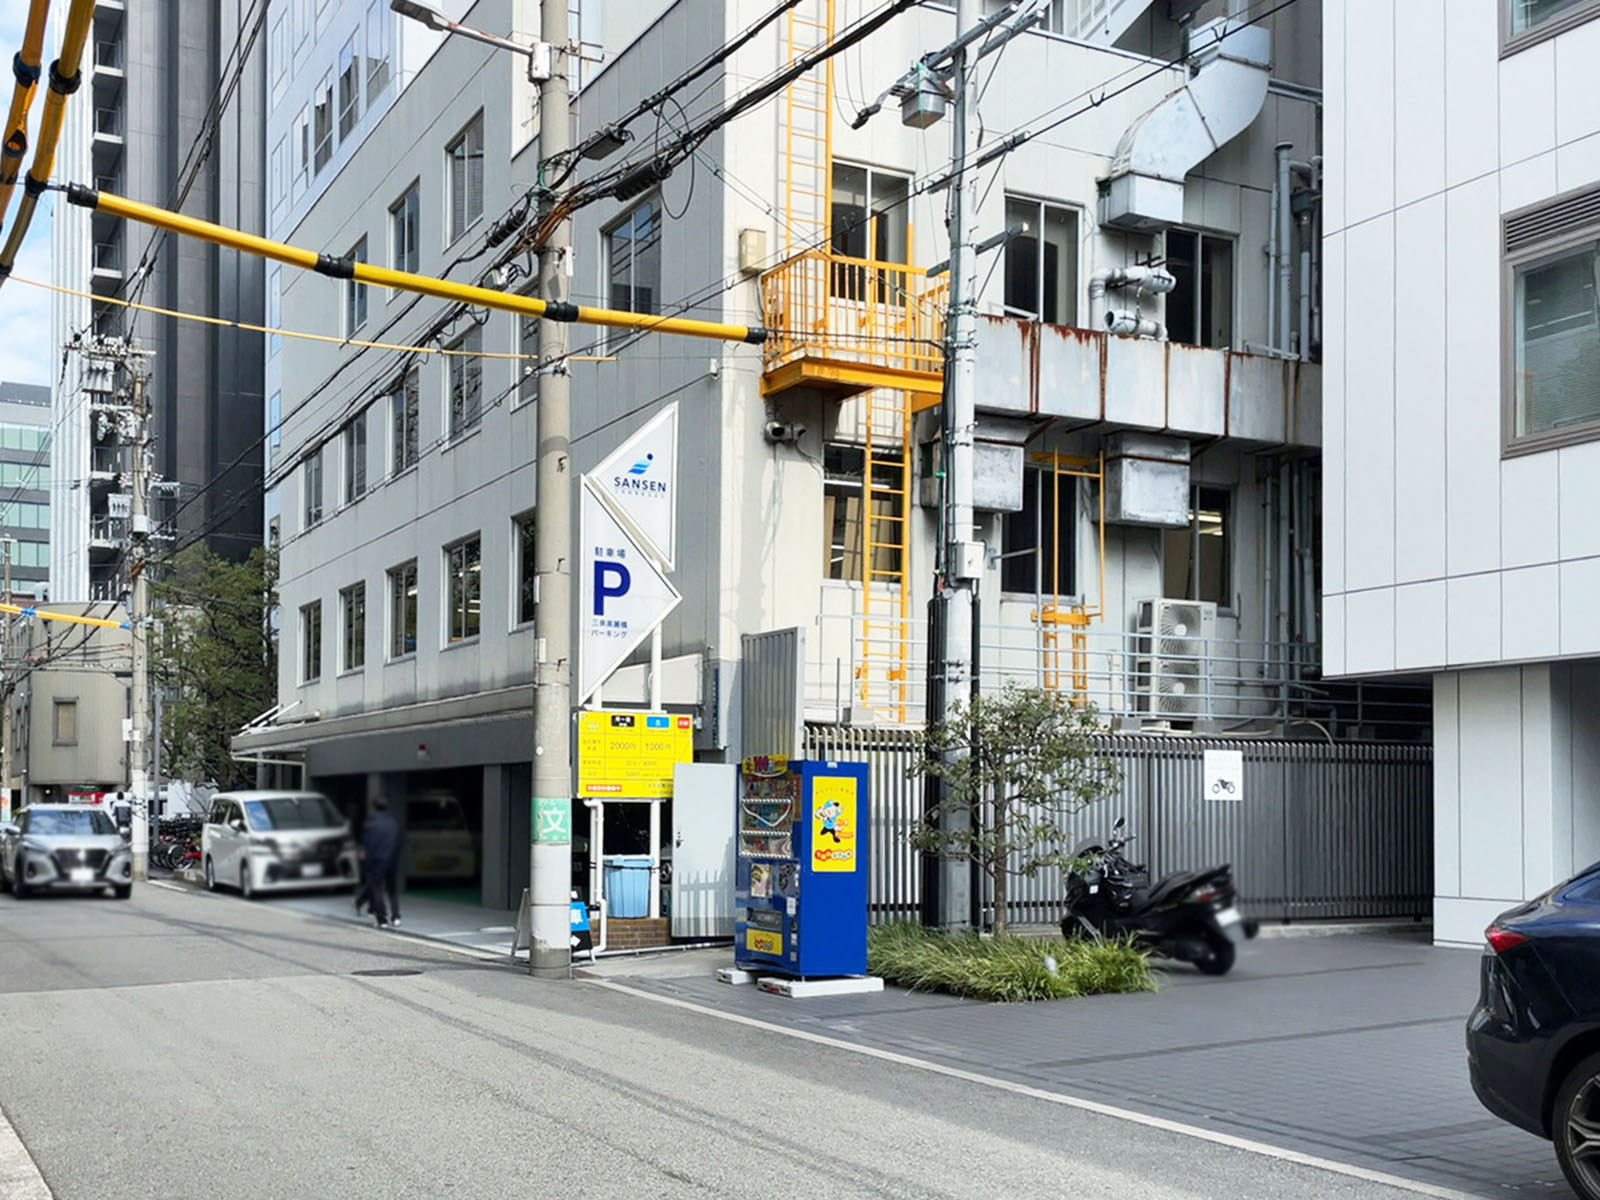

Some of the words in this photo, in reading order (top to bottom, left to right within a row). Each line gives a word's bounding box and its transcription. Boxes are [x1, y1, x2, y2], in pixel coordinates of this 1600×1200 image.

[614, 476, 666, 492] SANSEN
[593, 560, 631, 616] P
[542, 807, 567, 833] 文
